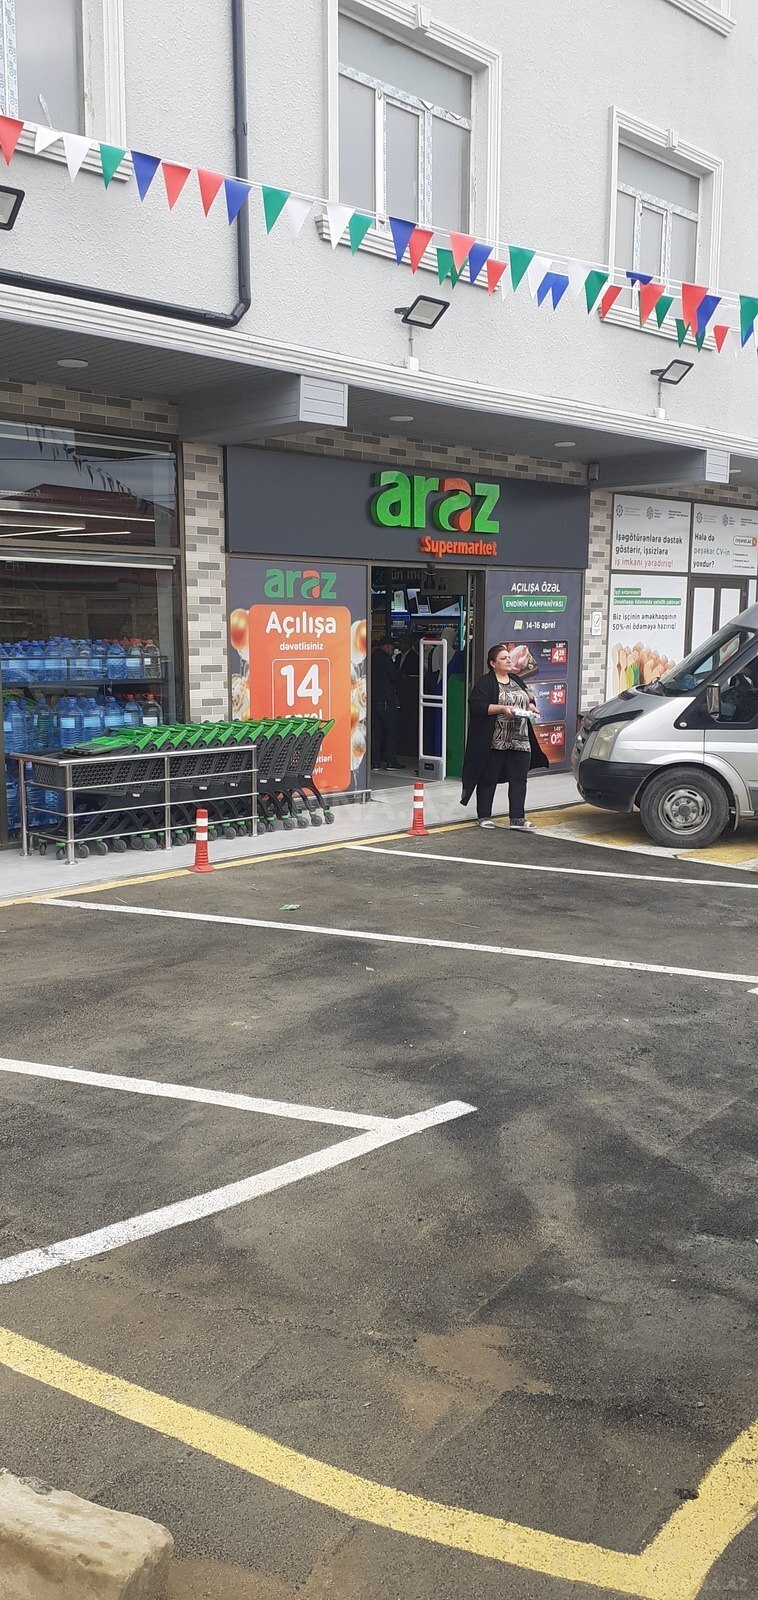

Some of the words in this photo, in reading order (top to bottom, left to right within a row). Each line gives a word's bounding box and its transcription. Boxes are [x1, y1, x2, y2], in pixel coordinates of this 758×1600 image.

[371, 470, 500, 533] araz
[420, 535, 498, 558] Supermarket
[264, 568, 337, 599] araz
[511, 582, 540, 594] AÇILIŞA
[541, 581, 561, 593] ÖZƏL
[505, 599, 529, 608] ENDİRİM
[530, 599, 564, 608] KAMPANİYASI
[265, 611, 337, 638] Açılışa
[526, 621, 541, 629] 14-16
[541, 621, 556, 630] aprel
[612, 613, 622, 621] Biz
[279, 641, 324, 651] dəvətlisiniz
[280, 664, 323, 707] 14
